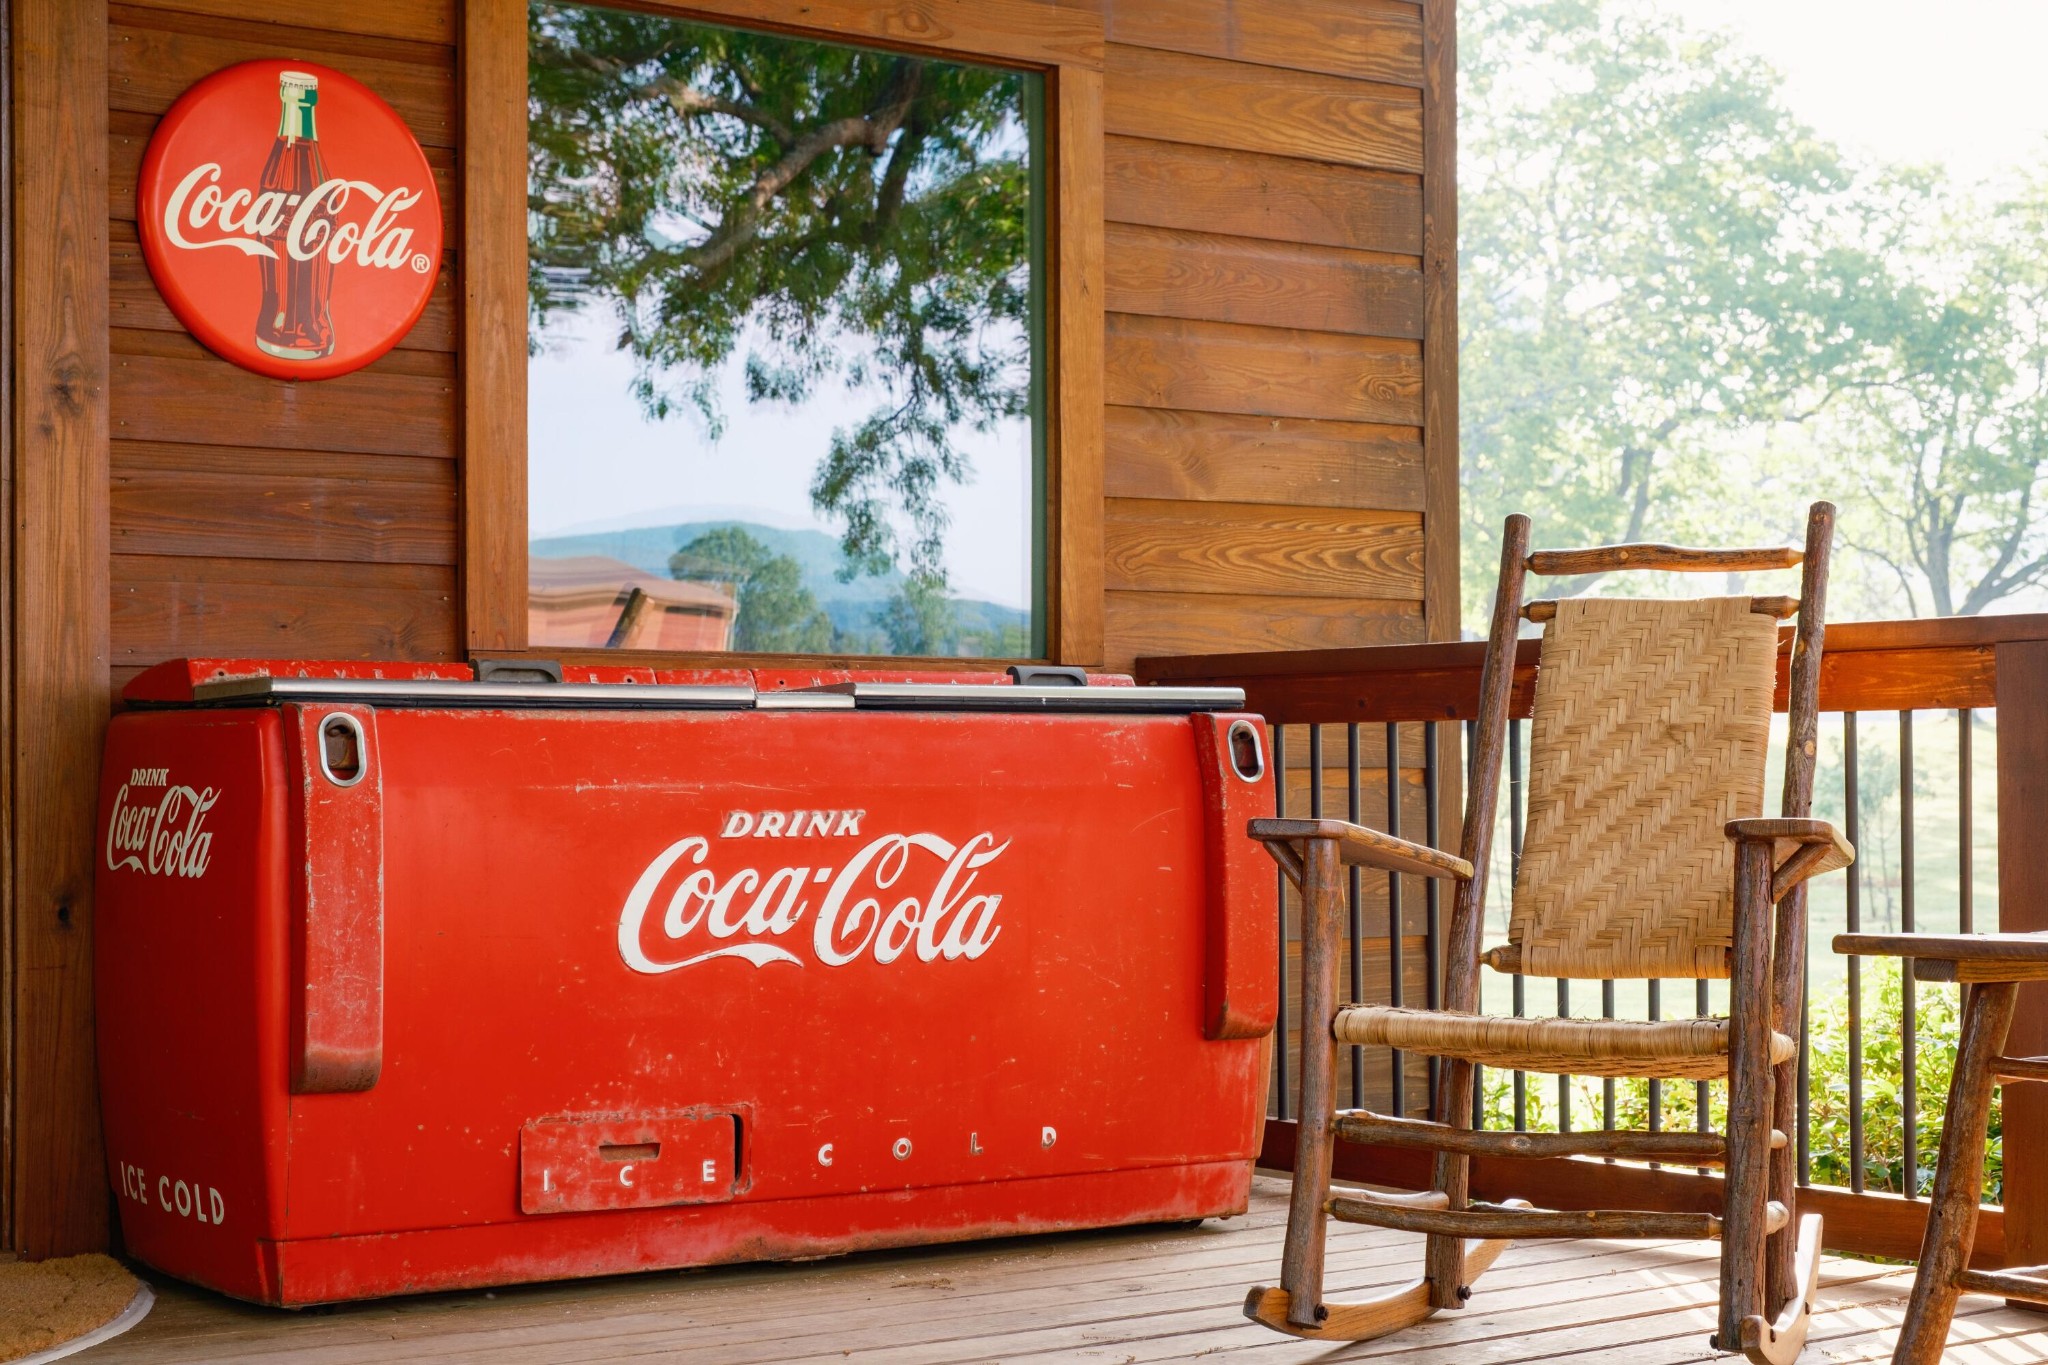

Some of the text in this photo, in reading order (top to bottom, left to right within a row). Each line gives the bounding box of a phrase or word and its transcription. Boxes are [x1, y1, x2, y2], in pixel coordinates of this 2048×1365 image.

[164, 162, 423, 270] Coca-Cola
[130, 768, 170, 787] DRINK
[107, 783, 222, 879] Coca-Cola
[720, 809, 866, 838] DRINK
[618, 831, 1012, 974] Coca-Cola
[817, 1126, 1058, 1167] COLD
[120, 1160, 225, 1225] ICE COLD
